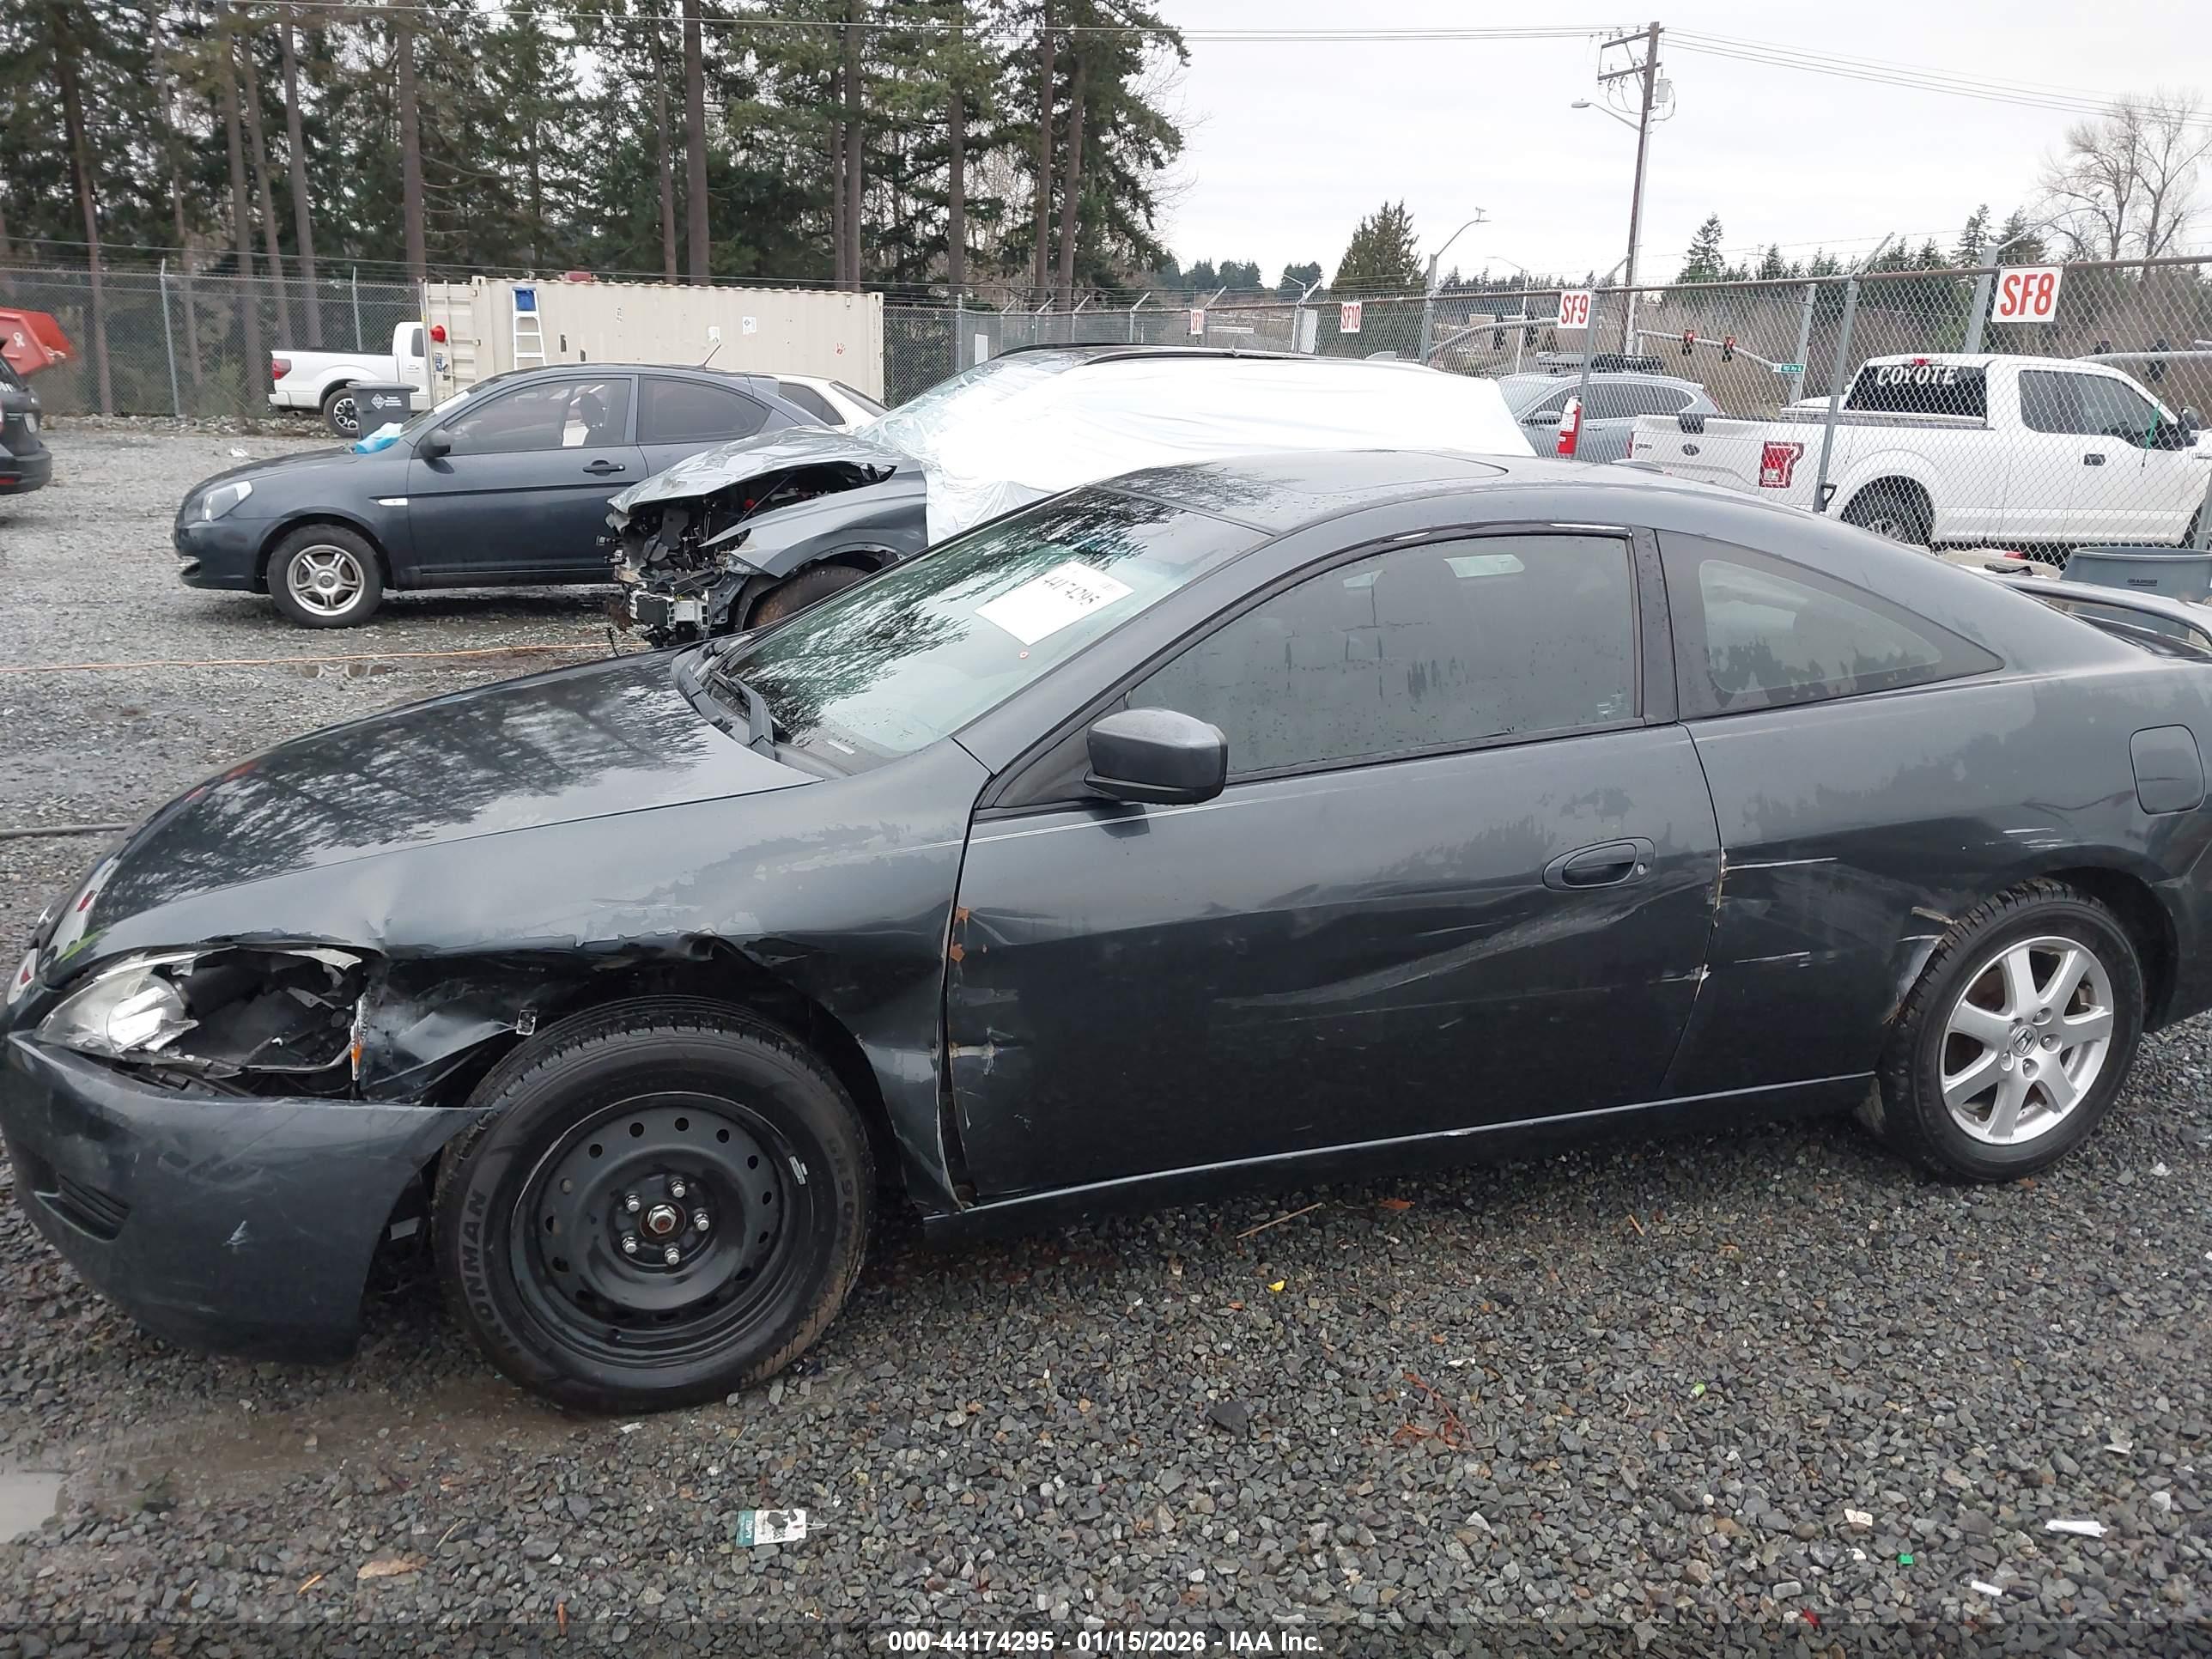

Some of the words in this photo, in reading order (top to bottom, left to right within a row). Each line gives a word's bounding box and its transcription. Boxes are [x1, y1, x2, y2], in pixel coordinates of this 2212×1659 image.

[2000, 272, 2055, 316] SF8
[1341, 305, 1360, 330] SF10
[1561, 294, 1589, 325] SF9
[1876, 365, 1959, 386] COYOTE
